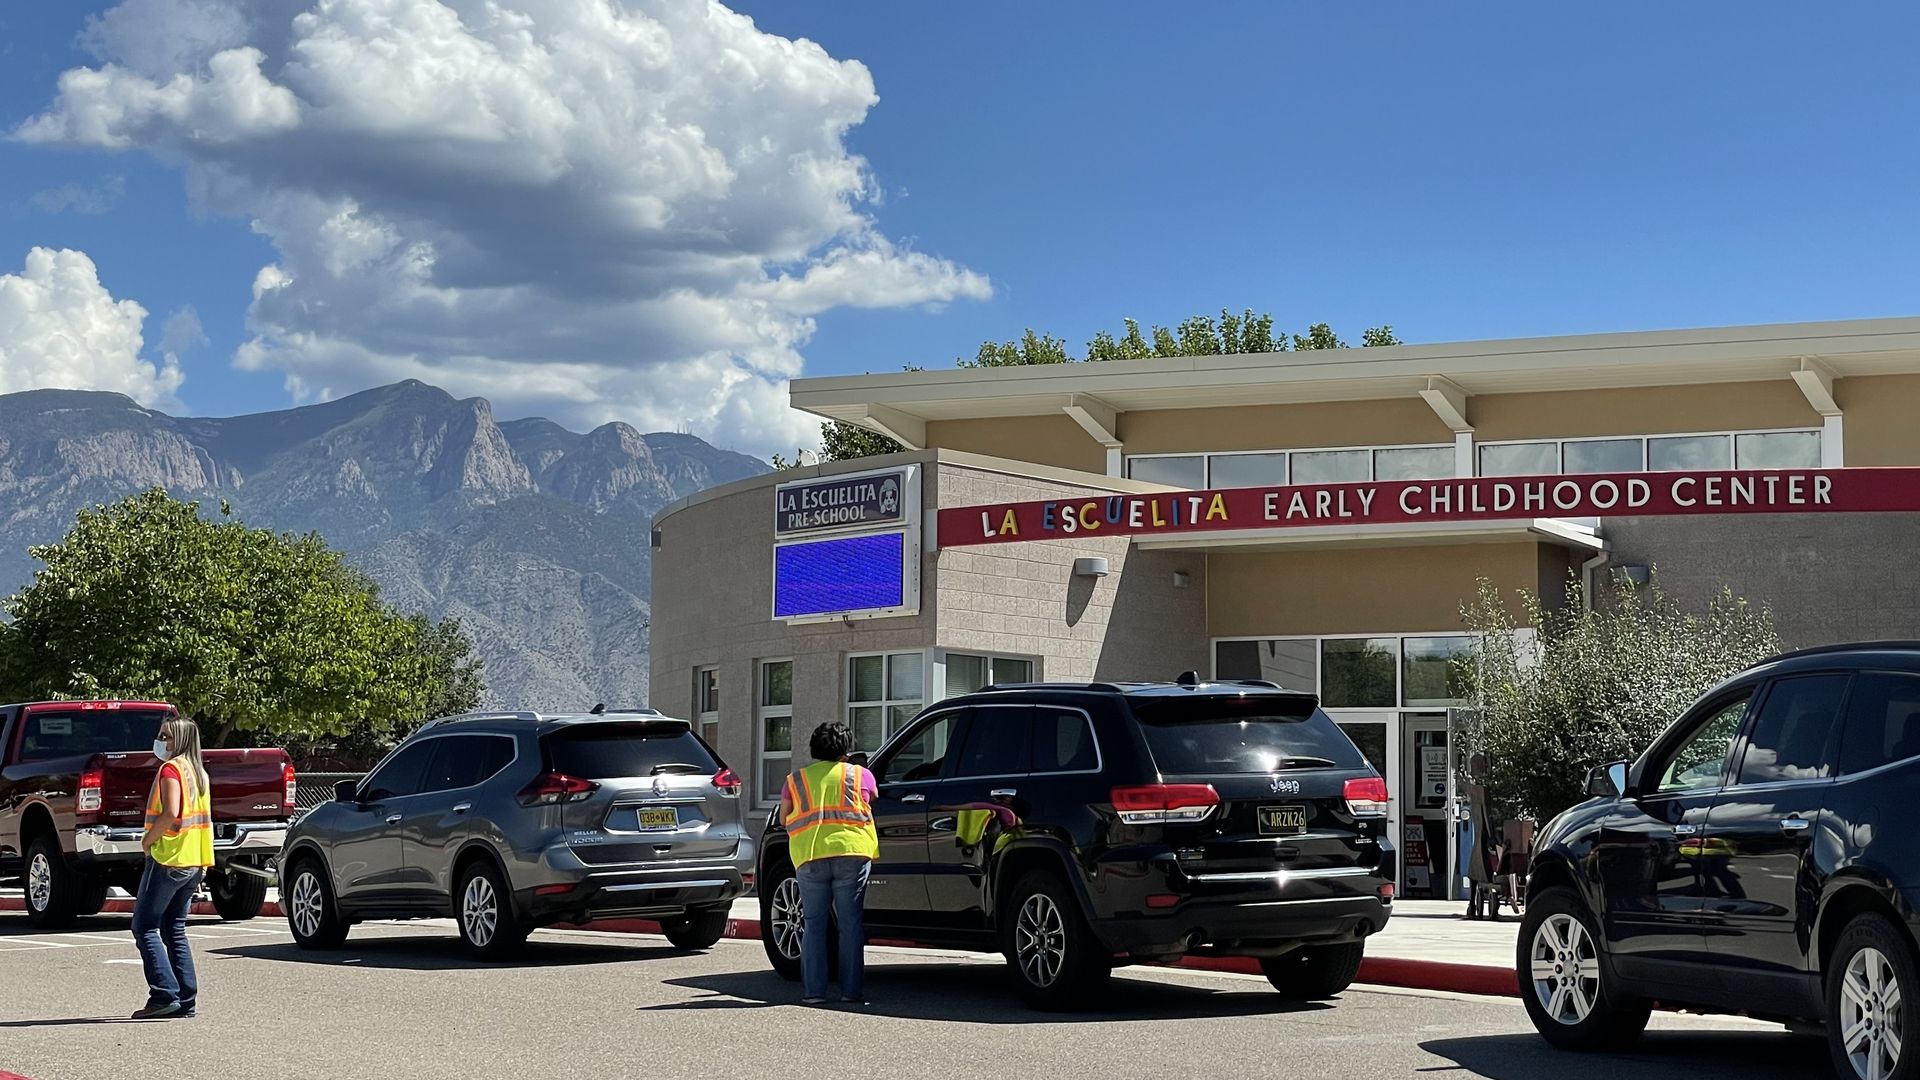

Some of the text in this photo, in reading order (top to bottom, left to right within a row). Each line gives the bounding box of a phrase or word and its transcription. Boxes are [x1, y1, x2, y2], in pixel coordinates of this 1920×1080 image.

[779, 483, 877, 512] LA ESCUELITA
[981, 475, 1832, 538] LA ESCUELITA EARLY CHILDHOOD CENTER
[788, 505, 867, 528] PRE-SCHOOL
[1270, 778, 1300, 794] Jeep
[1270, 811, 1305, 827] ARZK26
